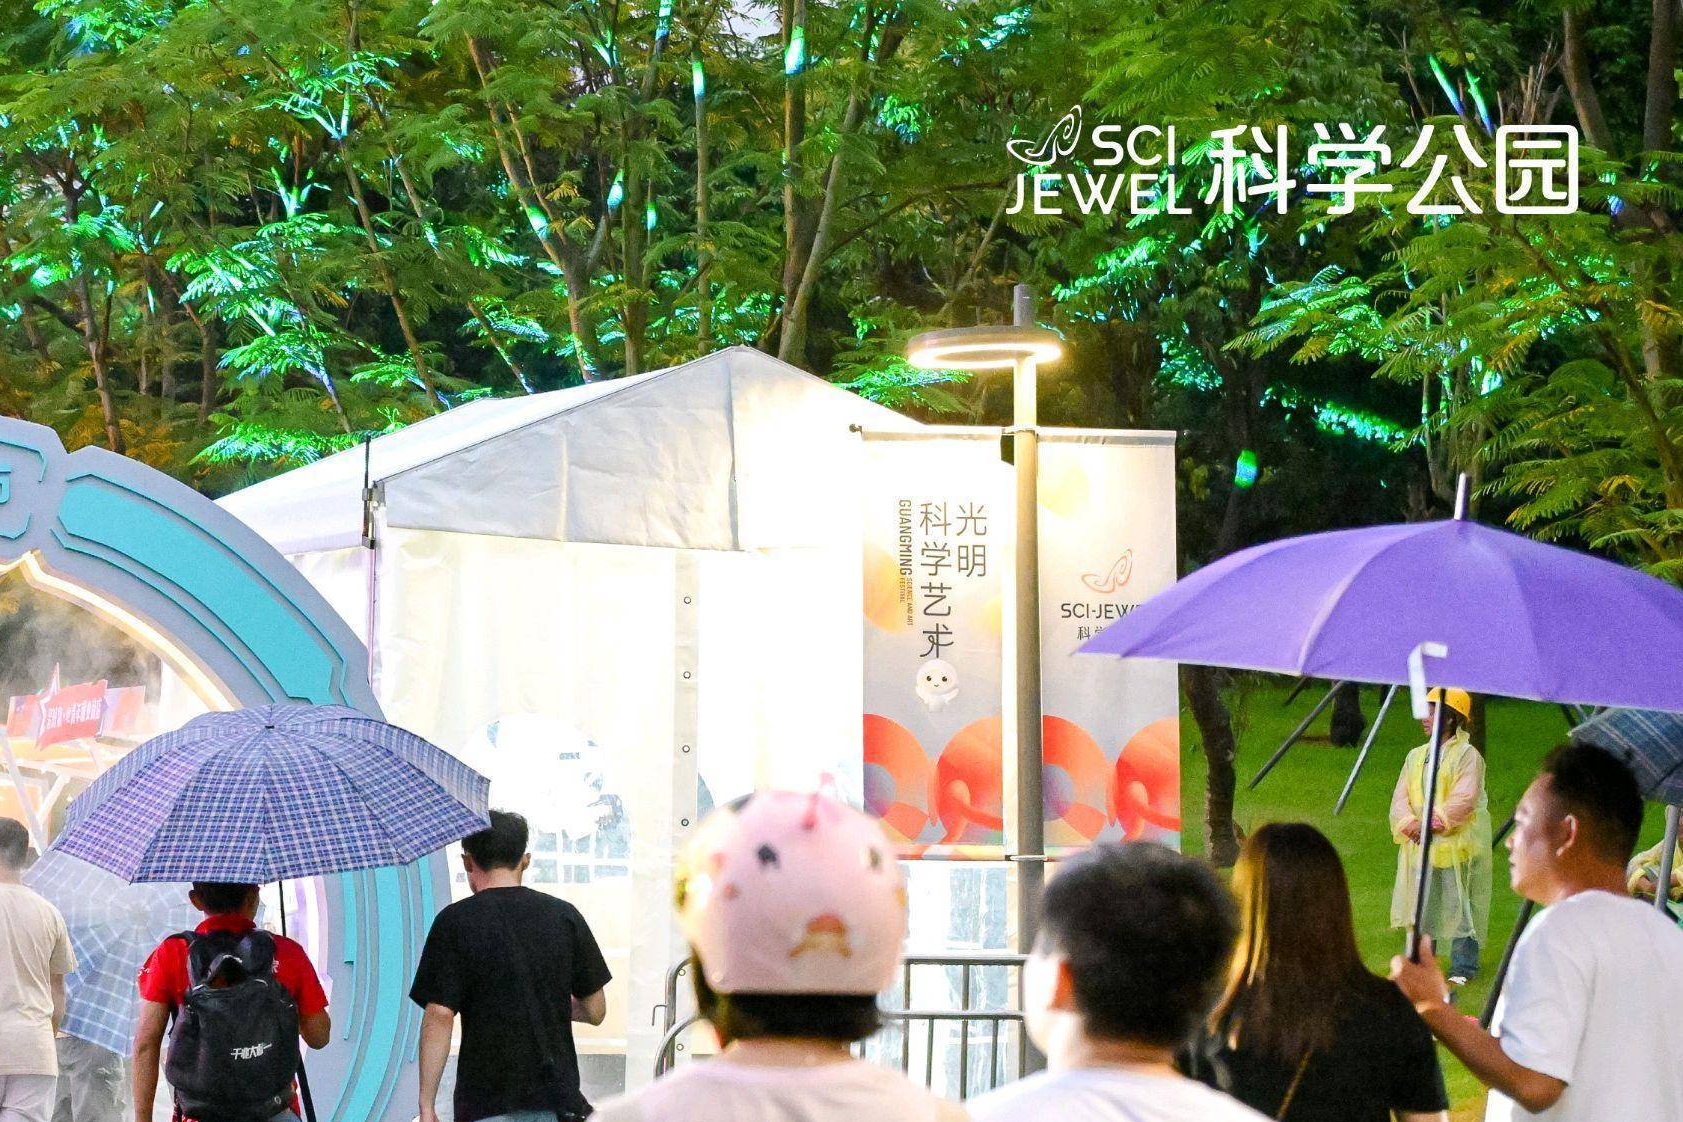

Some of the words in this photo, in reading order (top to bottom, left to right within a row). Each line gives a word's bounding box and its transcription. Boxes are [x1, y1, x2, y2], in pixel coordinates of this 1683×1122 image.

[899, 499, 913, 576] GUANGMING
[956, 501, 988, 578] 光明
[919, 501, 955, 660] 科学艺术
[1061, 603, 1140, 620] SCI-JEW
